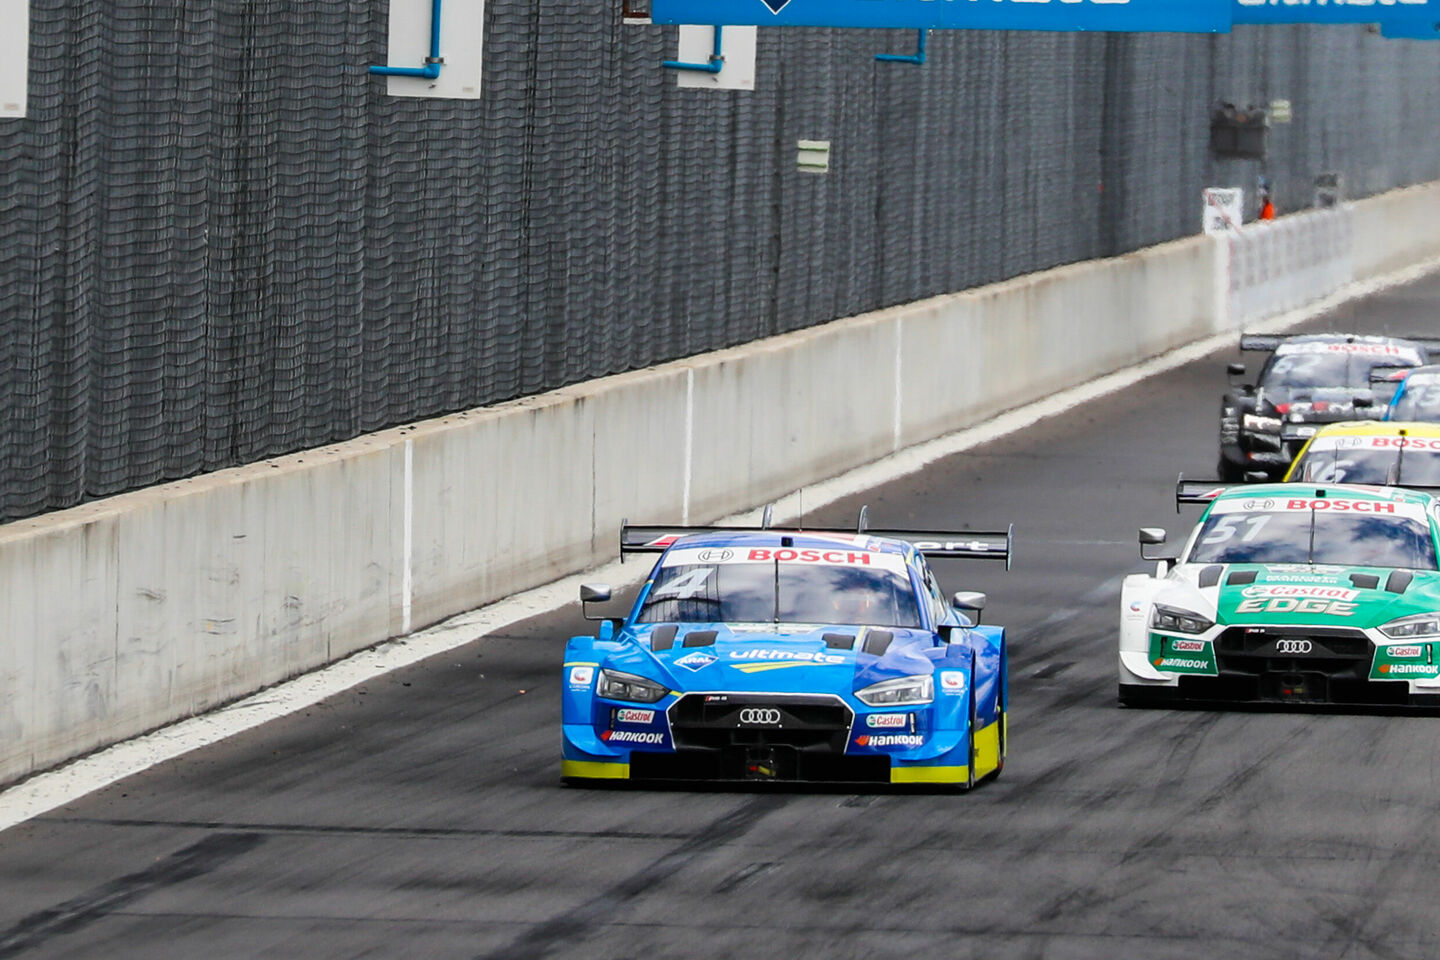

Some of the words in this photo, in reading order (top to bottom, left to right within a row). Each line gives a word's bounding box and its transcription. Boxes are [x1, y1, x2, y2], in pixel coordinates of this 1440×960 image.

[1287, 500, 1395, 513] BOSCH
[1203, 515, 1272, 545] 51
[748, 549, 870, 565] BOSCH
[654, 568, 714, 599] 4
[1268, 586, 1348, 599] Castrol
[1235, 598, 1360, 617] EDGE
[1178, 641, 1203, 650] Castrol
[1395, 647, 1420, 656] Castrol
[680, 656, 712, 665] ARAL
[730, 648, 846, 664] ultimate
[624, 711, 653, 721] Castrol
[876, 715, 904, 725] Castrol
